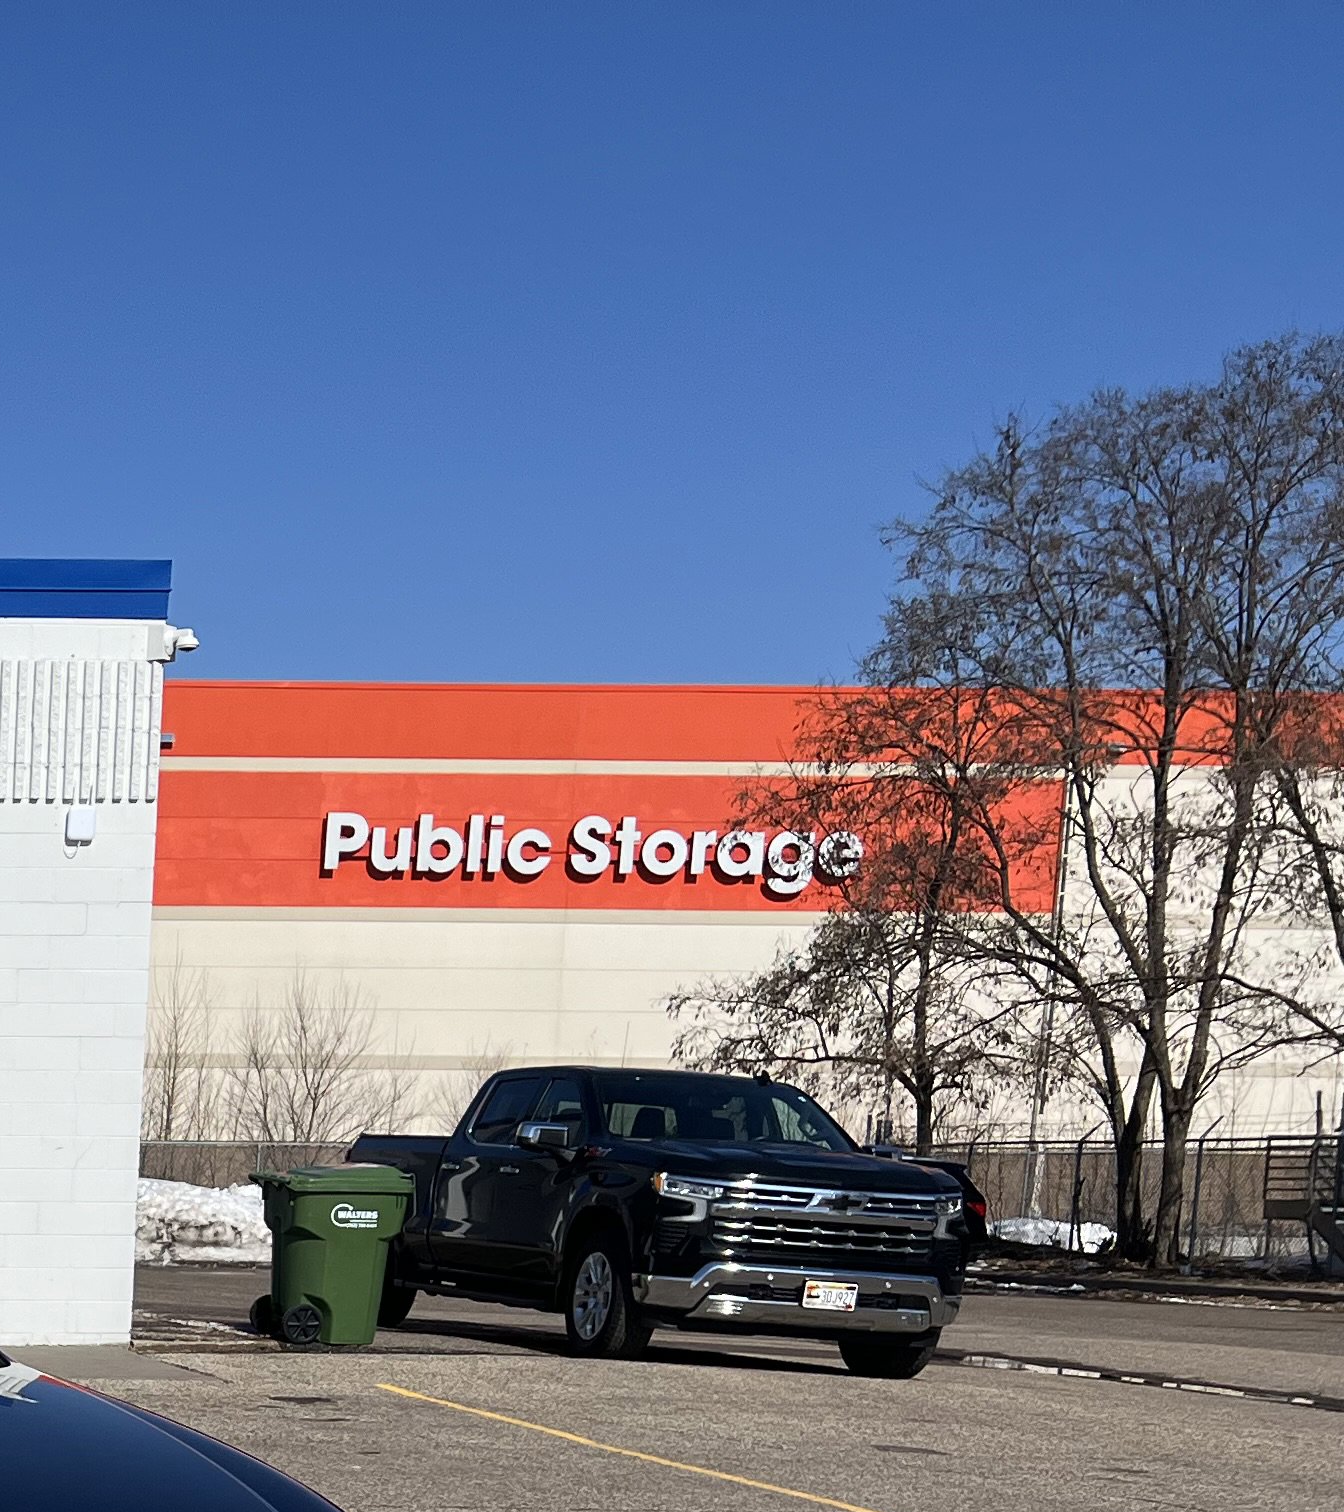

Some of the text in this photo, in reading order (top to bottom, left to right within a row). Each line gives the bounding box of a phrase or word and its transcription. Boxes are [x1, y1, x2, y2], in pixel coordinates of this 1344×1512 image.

[322, 811, 864, 895] Public Storage
[337, 1210, 378, 1219] WALTERS
